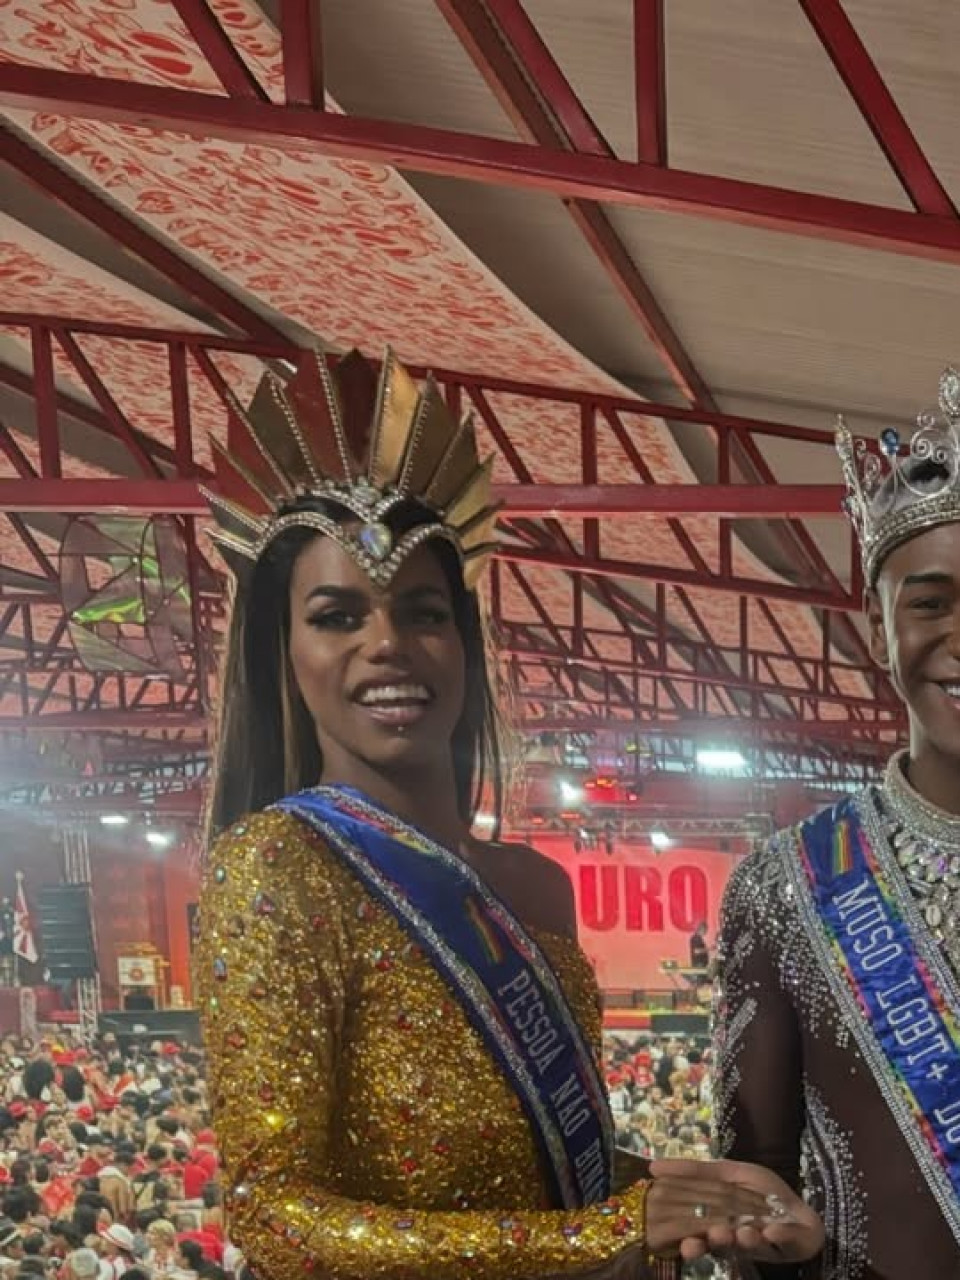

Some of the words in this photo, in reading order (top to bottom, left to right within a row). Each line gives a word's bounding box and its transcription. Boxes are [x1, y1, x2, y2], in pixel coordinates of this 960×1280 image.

[498, 969, 566, 1075] PESSOA
[832, 879, 903, 972] MUSO
[876, 975, 951, 1082] LGBT+
